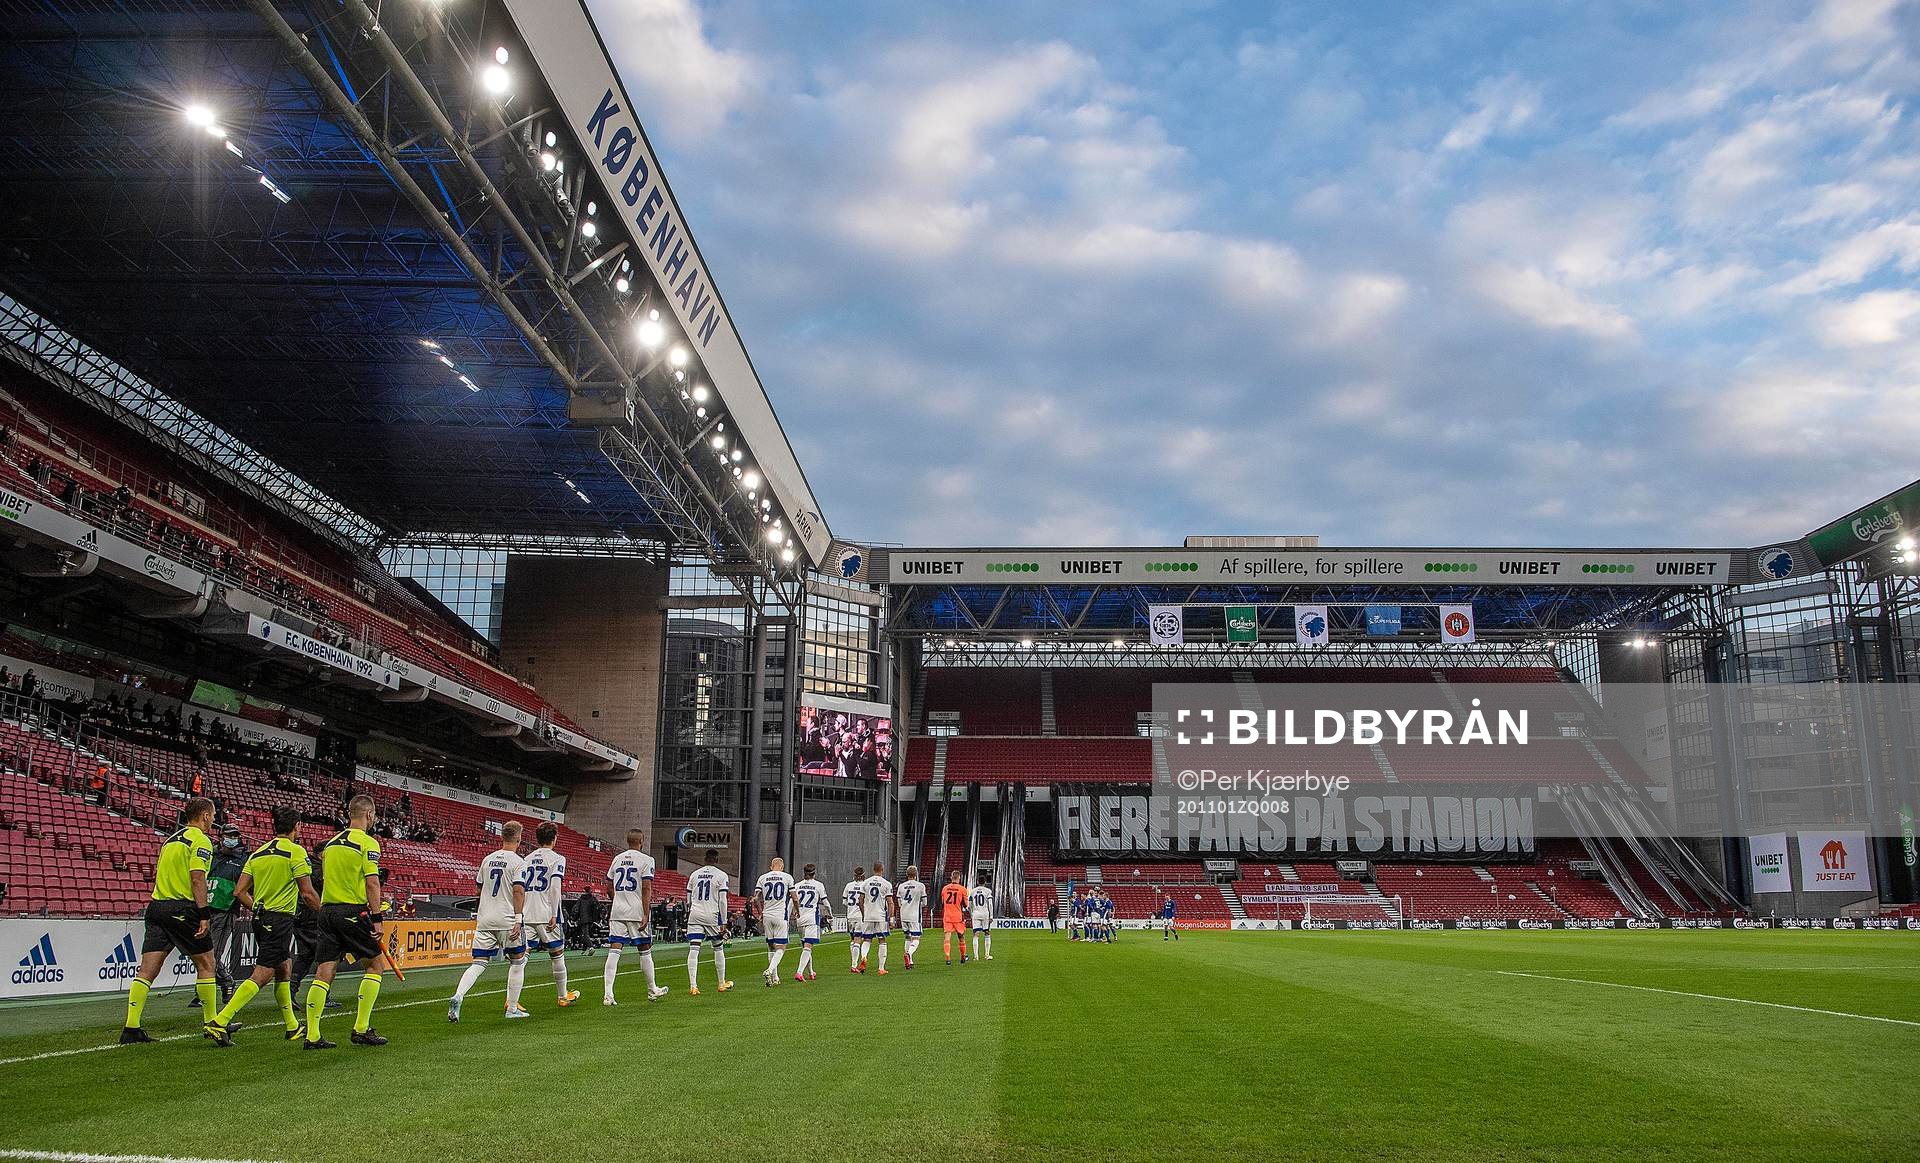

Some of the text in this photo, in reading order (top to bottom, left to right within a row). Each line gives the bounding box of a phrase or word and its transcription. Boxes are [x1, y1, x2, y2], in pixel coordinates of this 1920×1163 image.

[586, 88, 720, 348] KØBENHAVN
[795, 508, 813, 542] PARKEN
[1852, 511, 1904, 542] Carlsberg
[144, 554, 177, 580] Carlsberg
[902, 562, 964, 574] UNIBET
[1060, 560, 1122, 574] UNIBET
[1220, 558, 1404, 577] Af spillere, for spillere
[1500, 561, 1560, 575] UNIBET
[1656, 562, 1717, 575] UNIBET
[1230, 619, 1255, 629] Carlsberg
[286, 632, 373, 676] F.C. KØBENHAVN 1992
[244, 729, 264, 740] UNIBET
[1058, 782, 1534, 852] FLERE FANS PÅ STADION
[688, 833, 730, 842] RENVI
[1903, 828, 1918, 866] Carlsberg
[1754, 854, 1783, 867] UNIBET
[490, 868, 503, 897] 7
[525, 866, 548, 892] 23
[615, 868, 638, 892] 25
[1816, 873, 1837, 882] JUST
[697, 880, 710, 900] 11
[764, 882, 784, 900] 20
[870, 887, 879, 902] 9
[904, 890, 912, 904] 4
[798, 890, 815, 908] 22
[946, 892, 957, 904] 21
[974, 894, 985, 906] 10
[1301, 920, 1335, 929] Carlsberg
[1410, 920, 1443, 929] Carlsberg
[1518, 920, 1552, 929] Carlsberg
[1626, 920, 1660, 929] Carlsberg
[1733, 920, 1769, 929] Carlsberg
[407, 930, 476, 952] DANSKVAG
[12, 965, 64, 984] adidas
